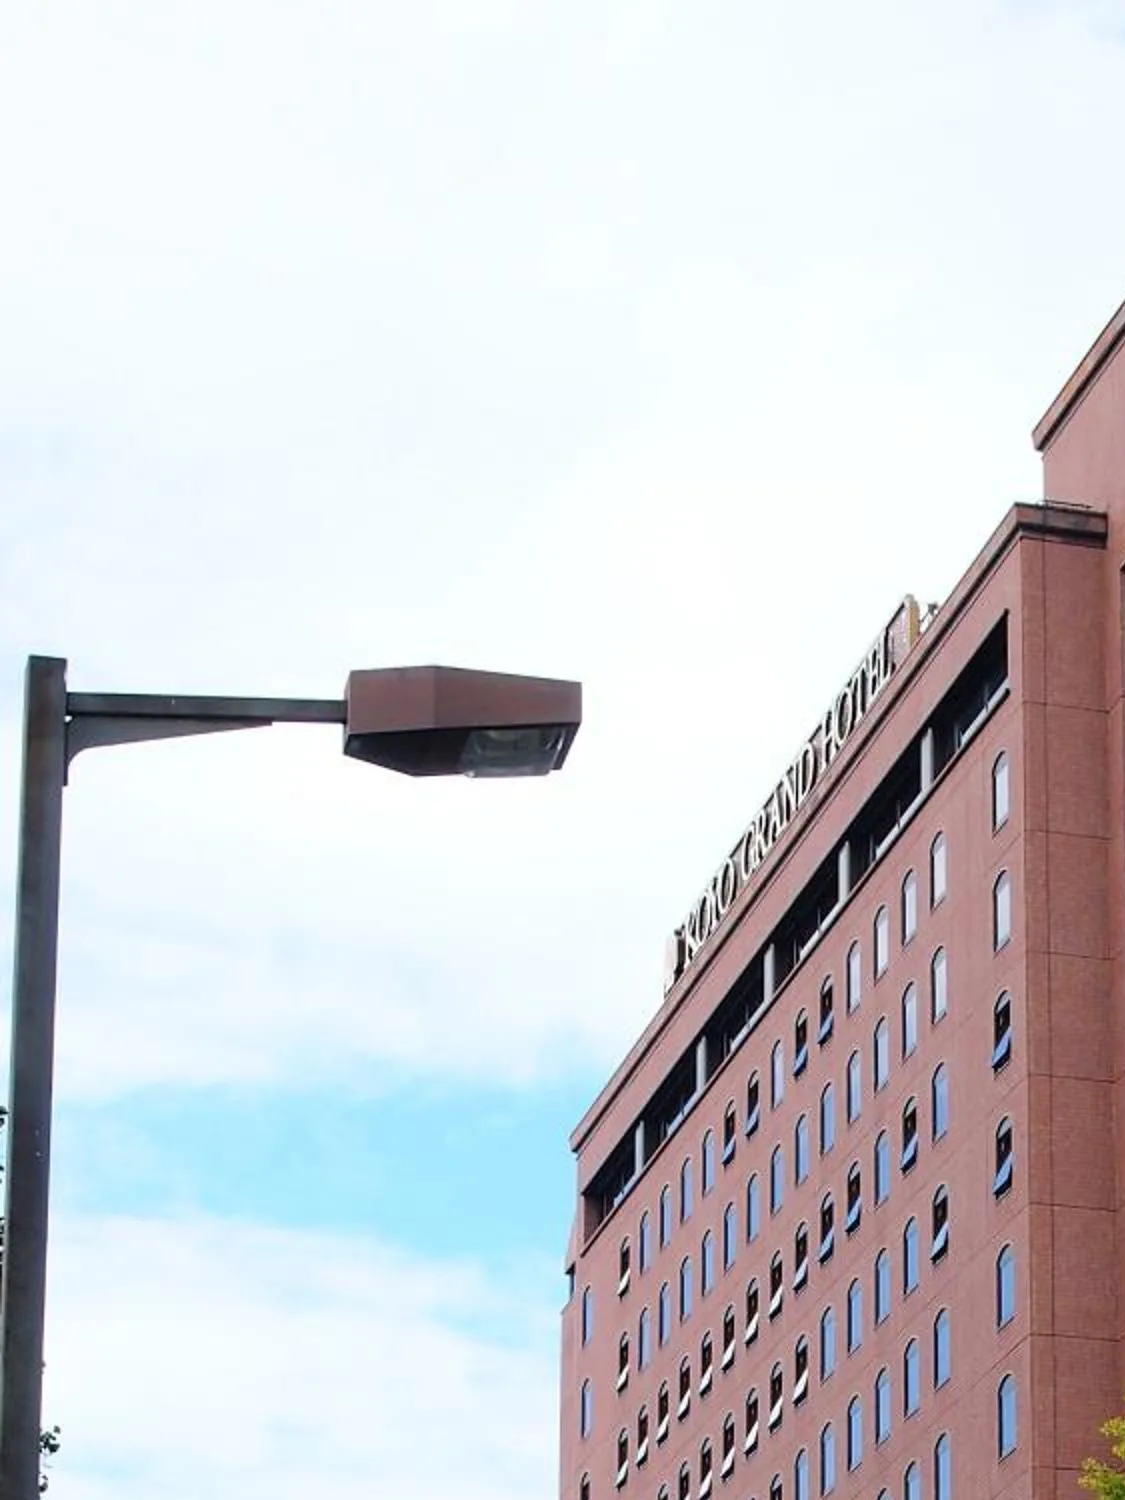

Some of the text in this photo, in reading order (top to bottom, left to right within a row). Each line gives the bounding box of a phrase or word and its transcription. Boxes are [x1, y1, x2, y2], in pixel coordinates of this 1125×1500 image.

[684, 628, 893, 968] KOYO GRAND HOTEL
